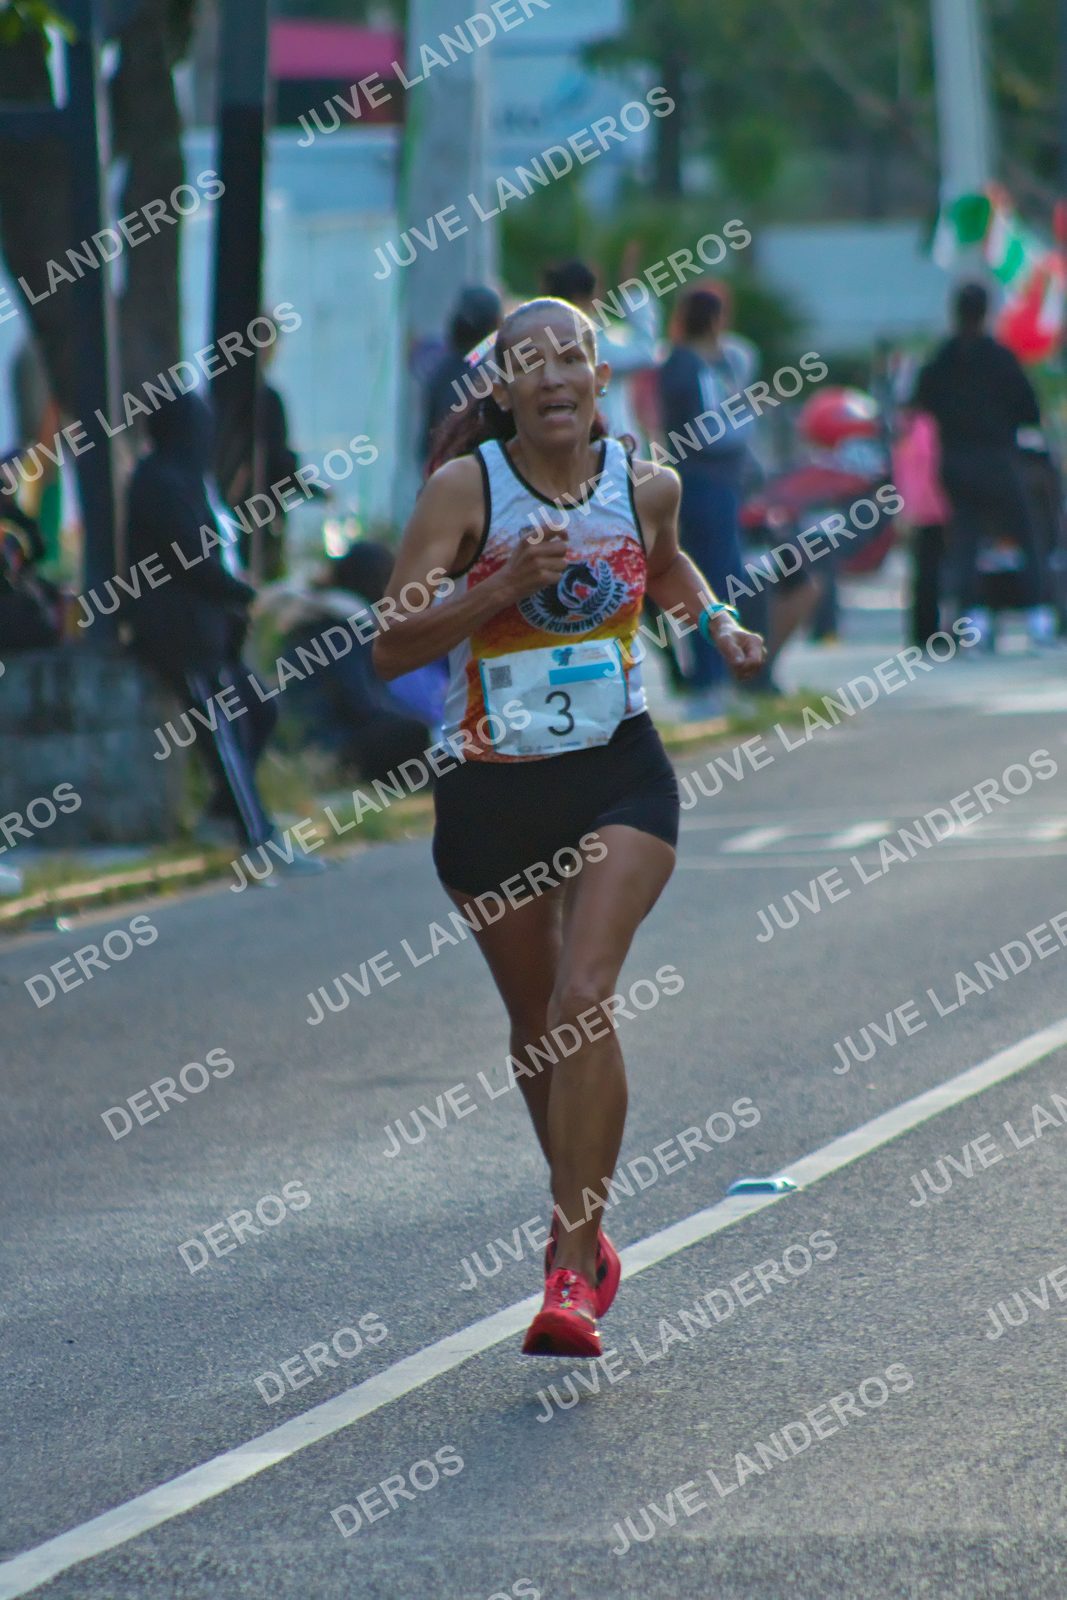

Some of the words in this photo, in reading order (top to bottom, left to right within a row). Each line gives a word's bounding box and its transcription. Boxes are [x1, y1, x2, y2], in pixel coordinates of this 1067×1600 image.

[545, 612, 604, 633] RUNNING
[603, 582, 625, 616] TEAM
[545, 691, 575, 737] 3
